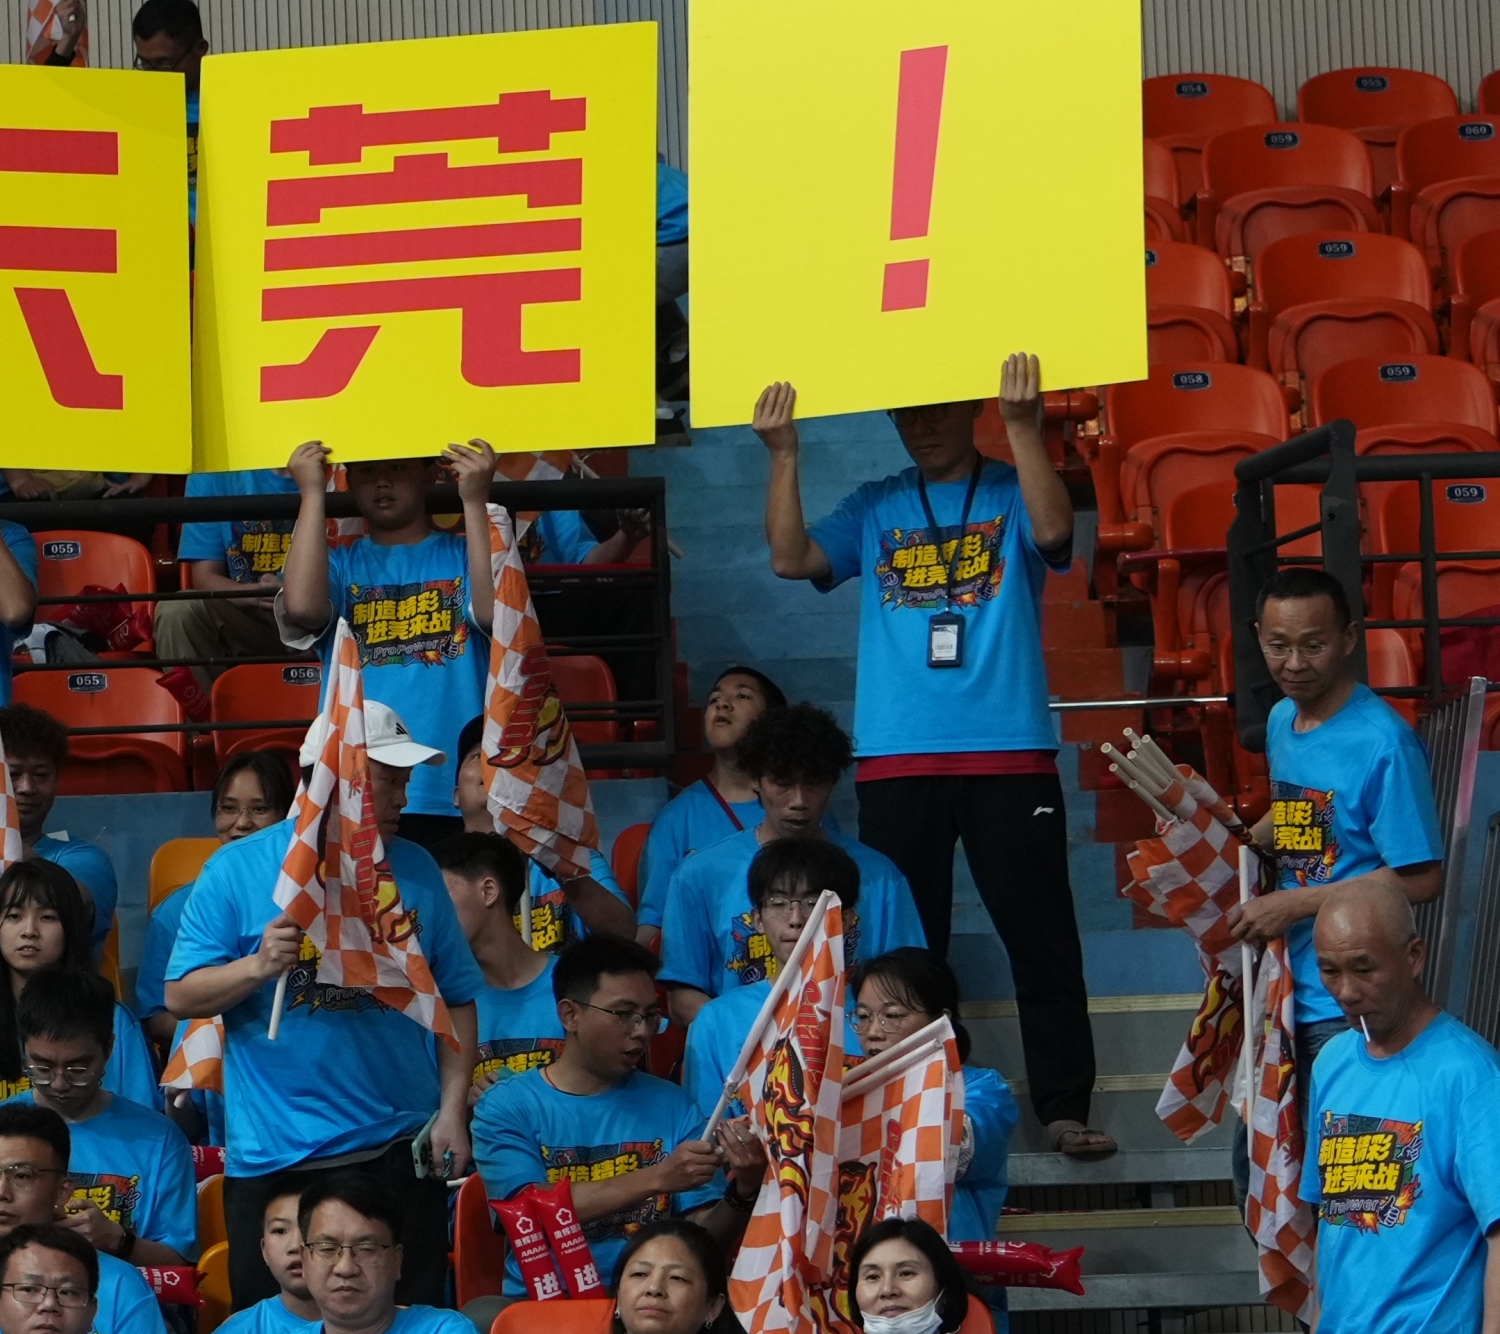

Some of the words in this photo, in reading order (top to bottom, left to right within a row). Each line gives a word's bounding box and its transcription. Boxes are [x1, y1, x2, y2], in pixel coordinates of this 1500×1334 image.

[1455, 487, 1477, 497] 059
[51, 542, 74, 556] 055
[353, 589, 440, 623] 制造精彩
[366, 613, 451, 645] 进莞来战
[76, 675, 99, 688] 055
[291, 668, 314, 678] 056
[1320, 1133, 1393, 1164] 制造精彩
[1324, 1162, 1399, 1195] 进莞来战
